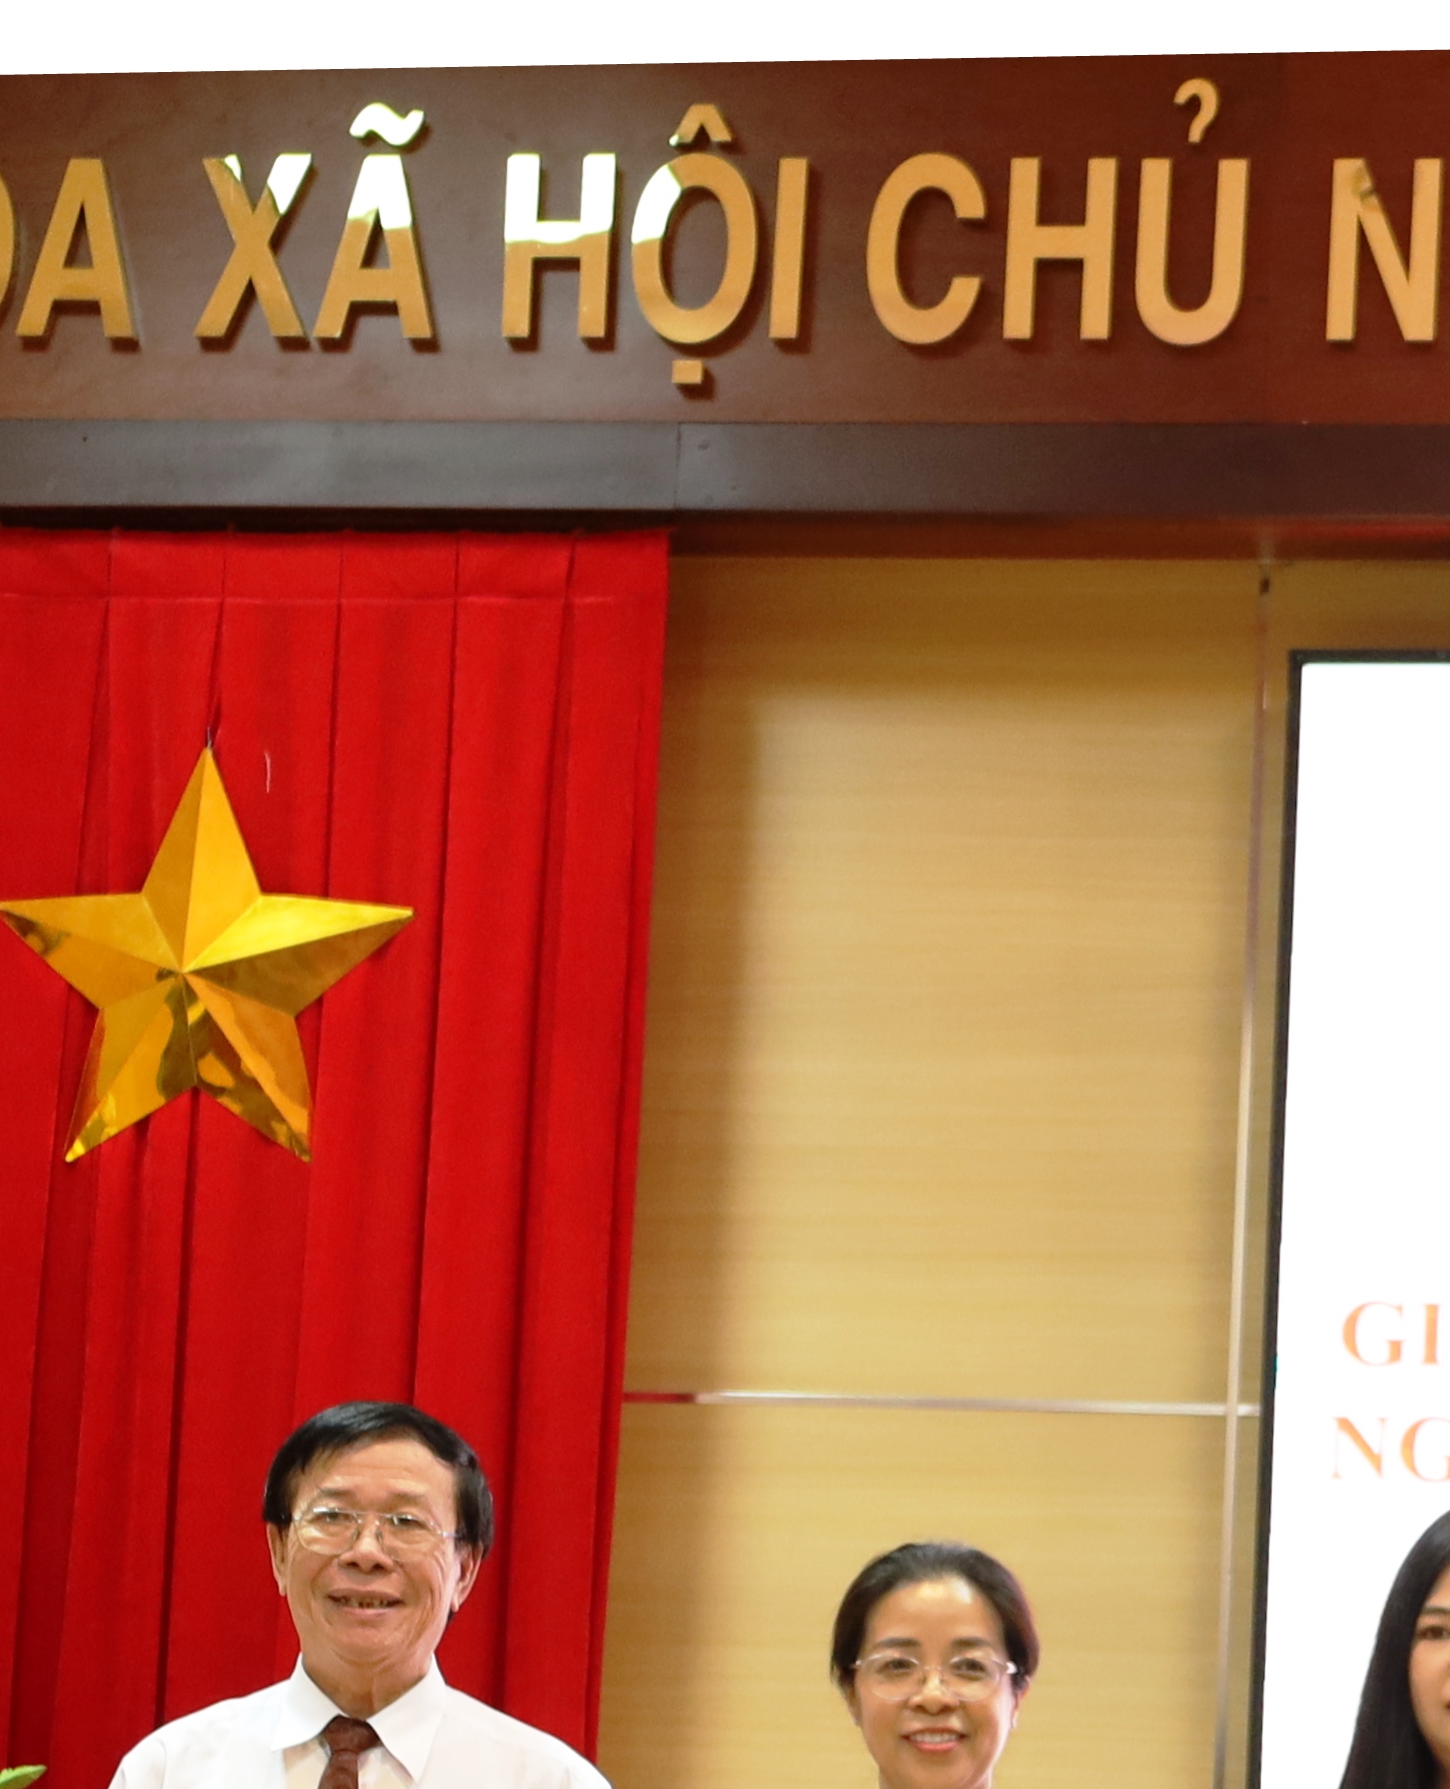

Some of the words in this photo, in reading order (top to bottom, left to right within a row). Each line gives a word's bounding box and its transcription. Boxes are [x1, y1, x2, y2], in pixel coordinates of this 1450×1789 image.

[195, 102, 434, 346] XÃ
[500, 103, 812, 386] HỘI
[864, 77, 1249, 348] CHỦ
